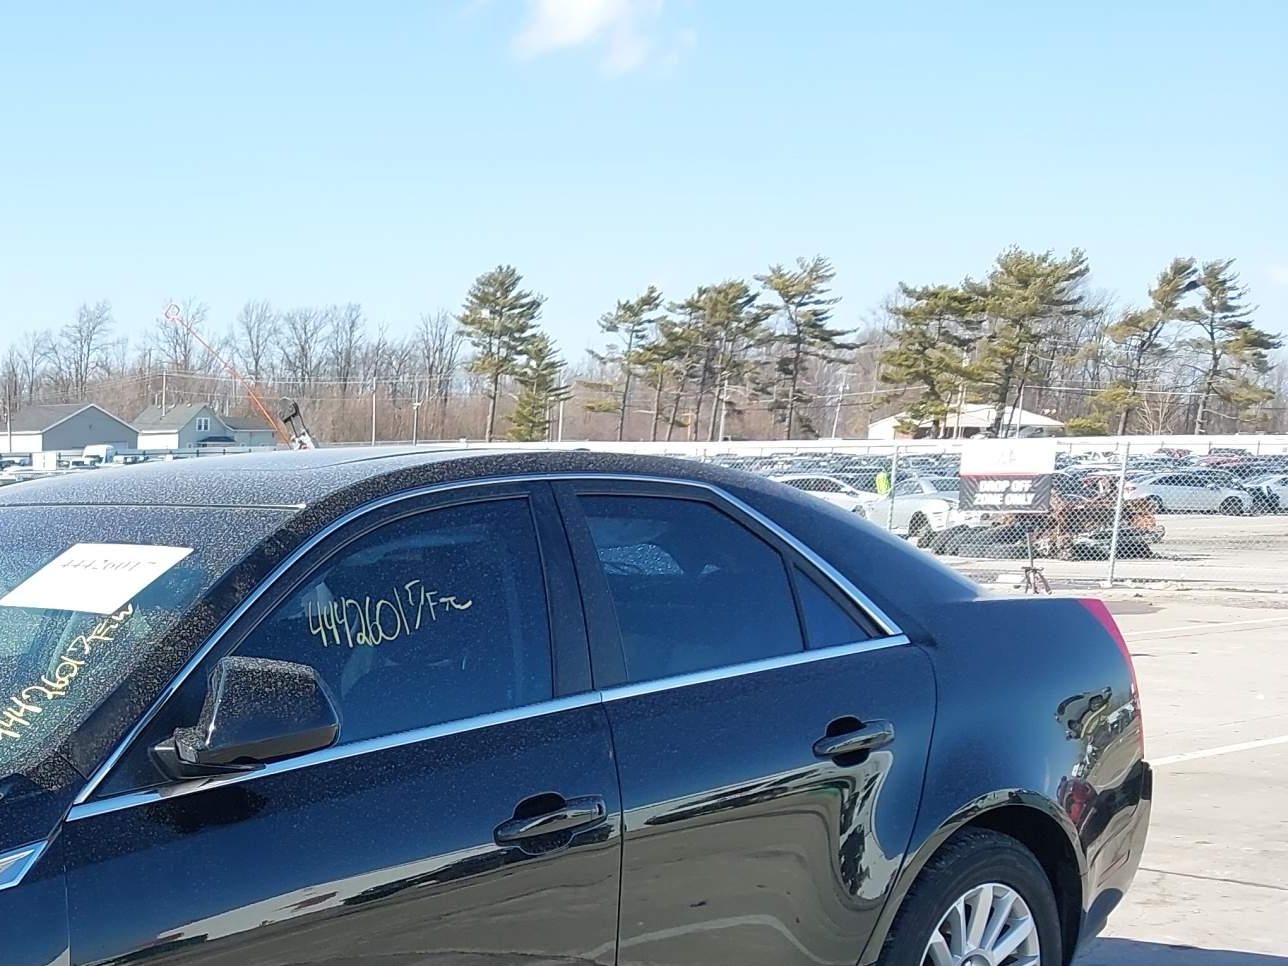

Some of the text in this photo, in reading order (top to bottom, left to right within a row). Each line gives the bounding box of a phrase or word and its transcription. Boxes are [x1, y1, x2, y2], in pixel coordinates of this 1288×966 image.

[979, 480, 1033, 492] DROP OFF
[973, 493, 1037, 505] ZONE ONLY
